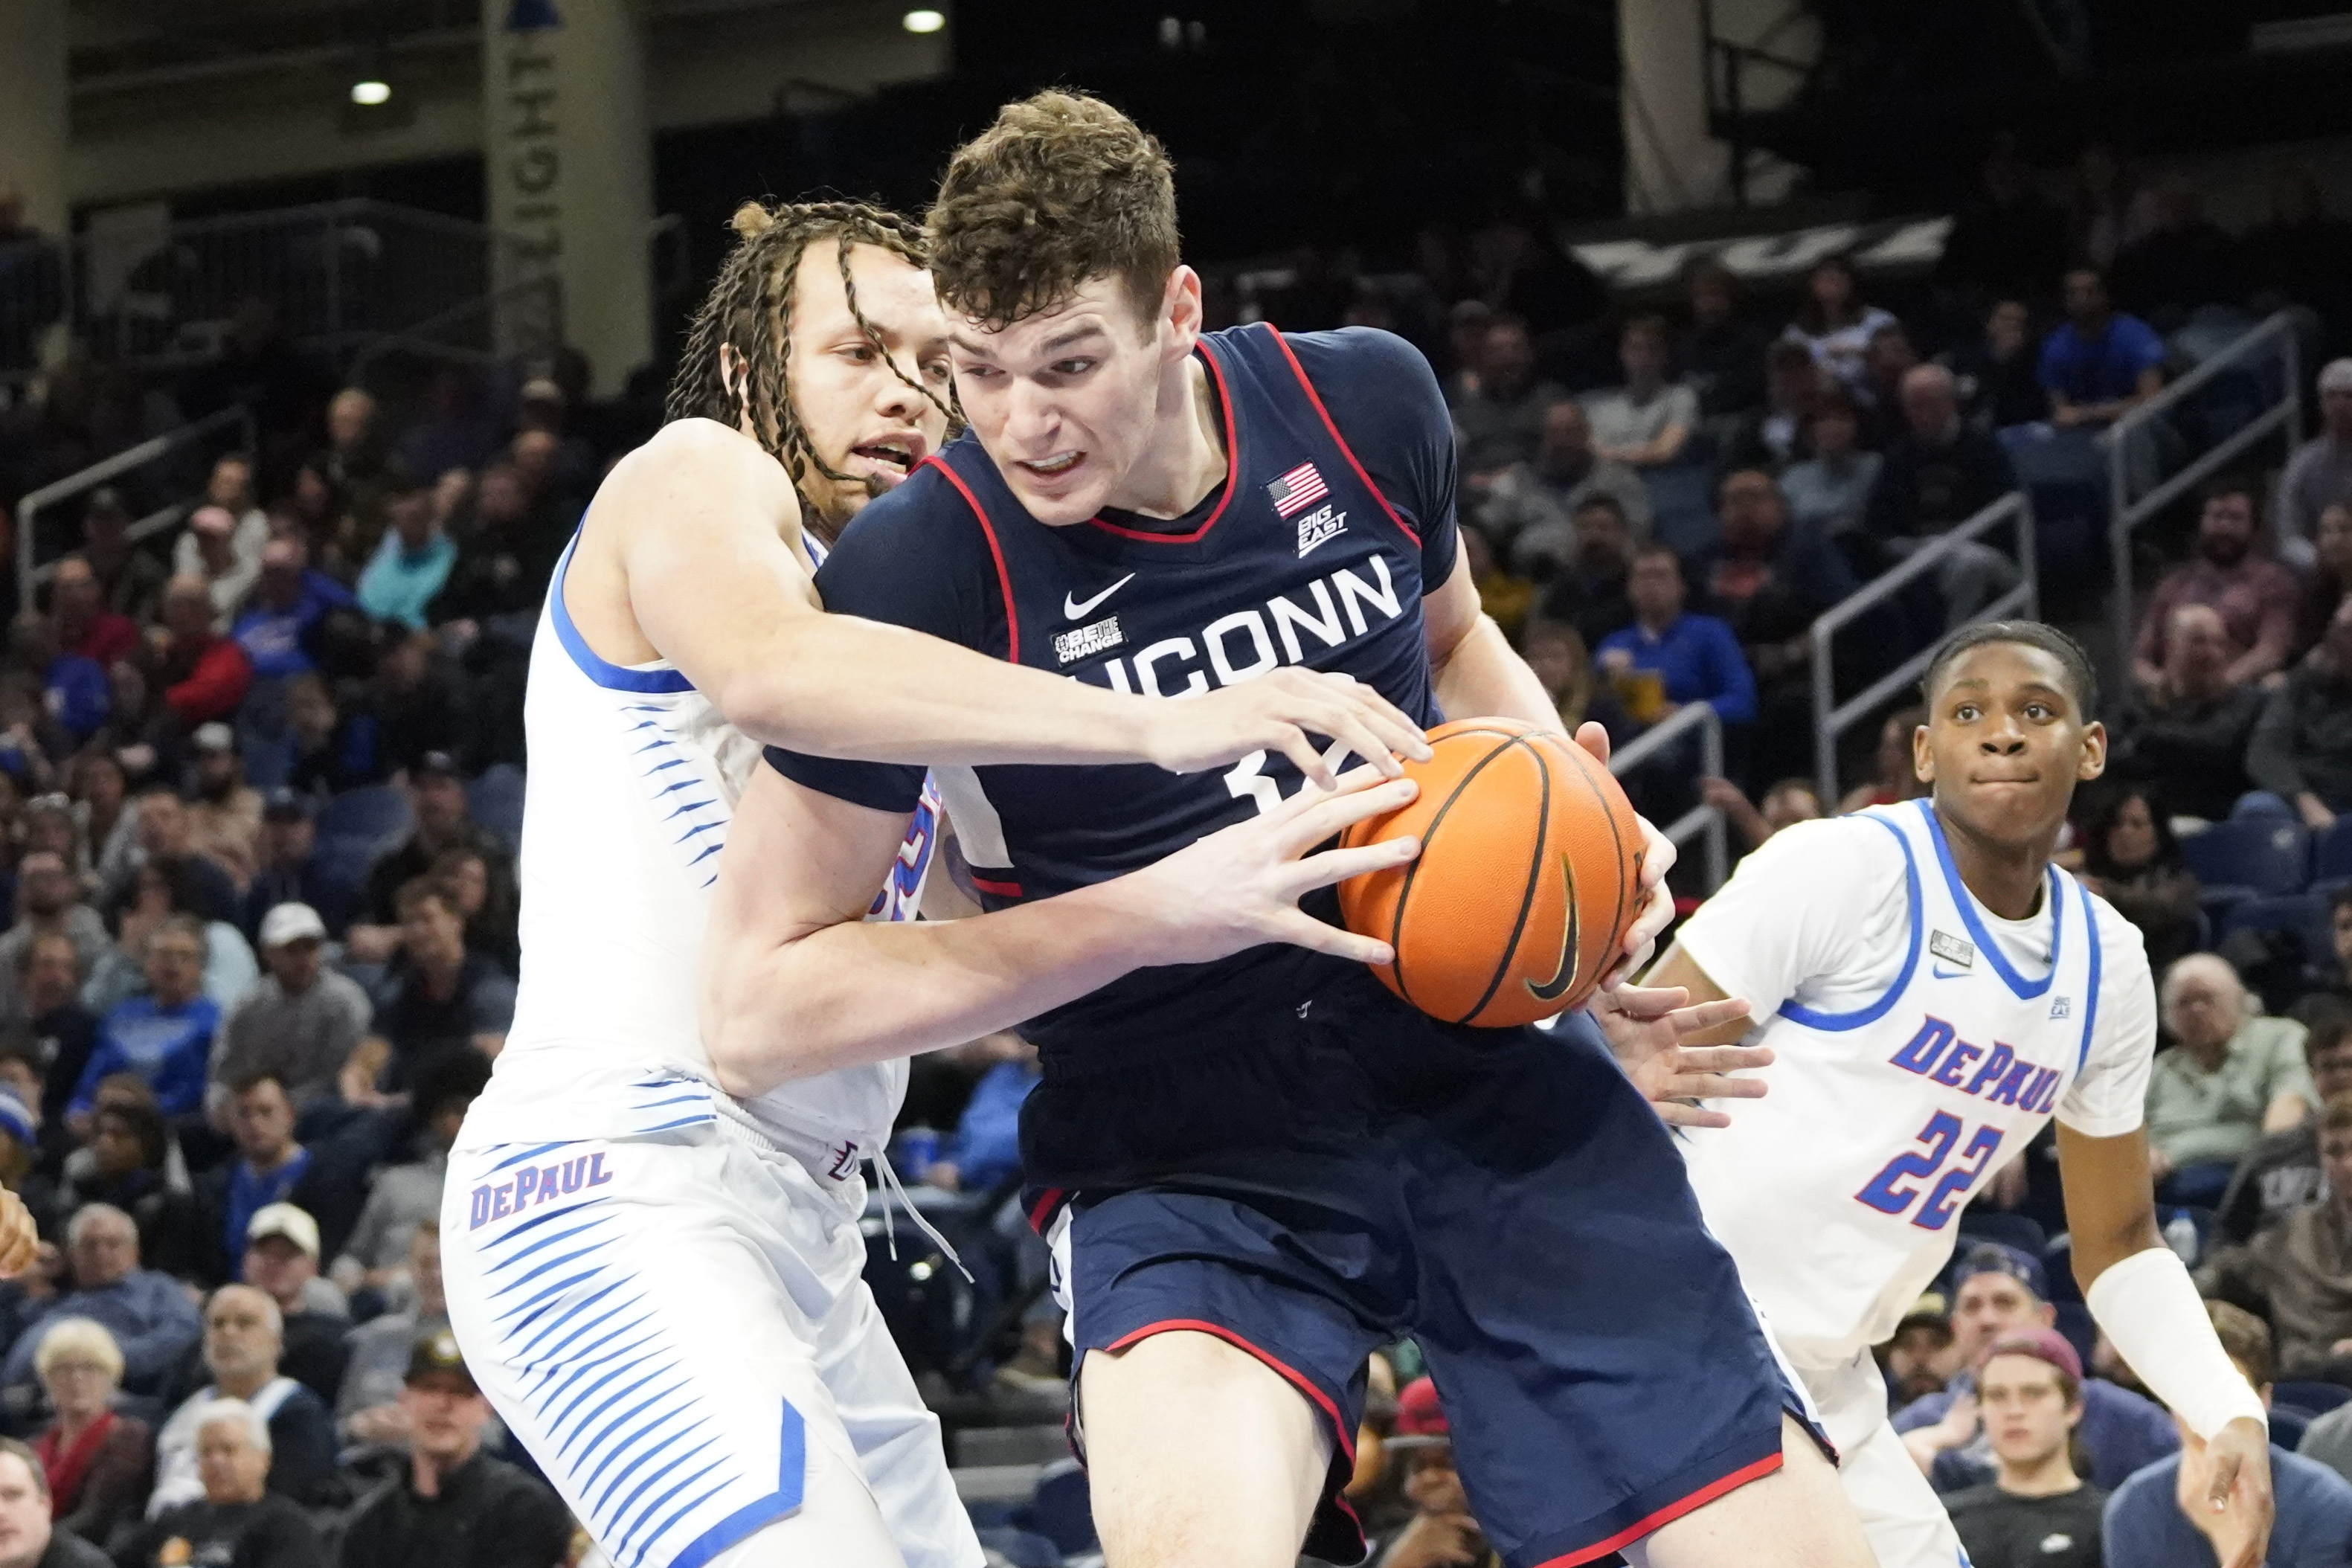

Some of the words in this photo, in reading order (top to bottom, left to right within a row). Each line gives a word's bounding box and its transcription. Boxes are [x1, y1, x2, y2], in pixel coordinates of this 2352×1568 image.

[1298, 504, 1331, 536] BIG
[1298, 511, 1347, 550] EAST
[1058, 631, 1123, 663] CHANGE
[1854, 1108, 2005, 1230] 22
